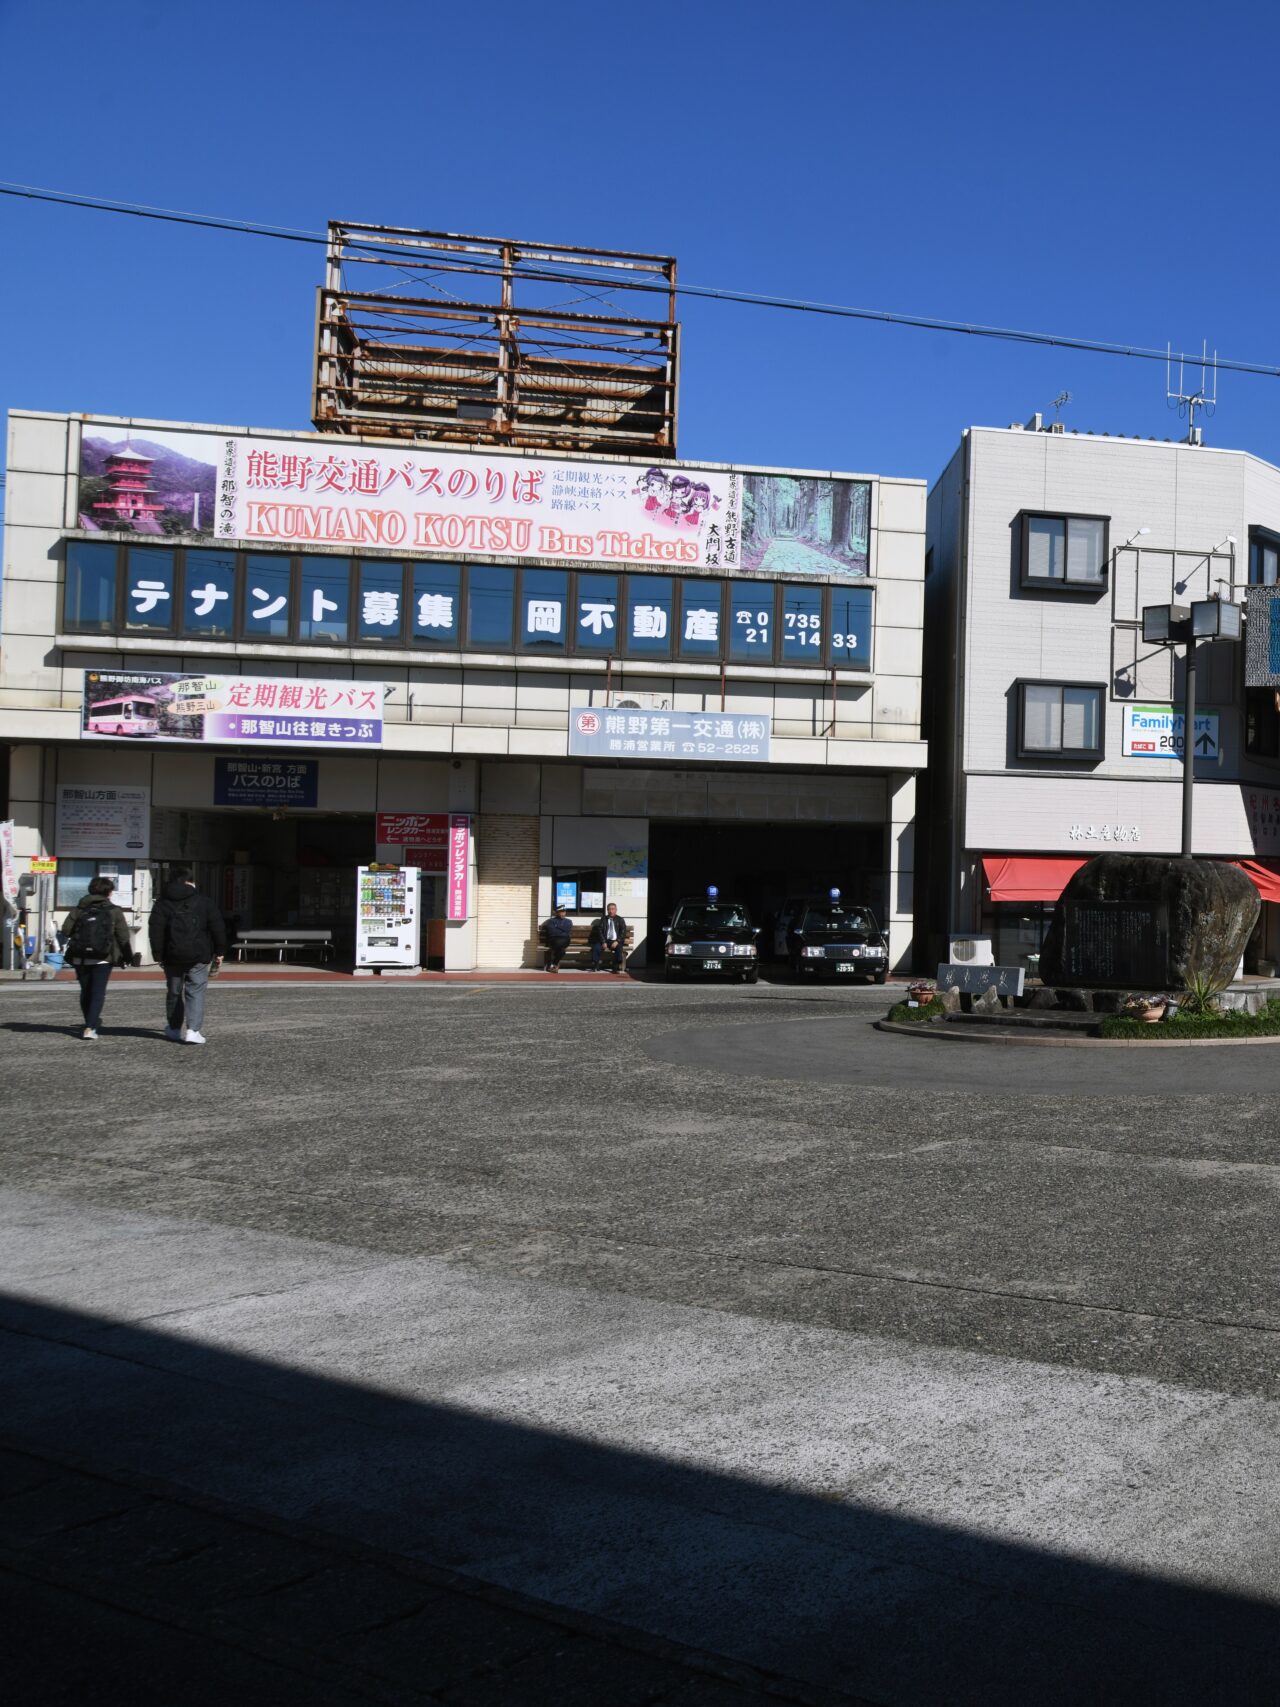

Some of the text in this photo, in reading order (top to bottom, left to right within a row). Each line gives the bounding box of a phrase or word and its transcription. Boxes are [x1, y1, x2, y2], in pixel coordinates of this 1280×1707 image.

[246, 449, 545, 504] 熊野交通バスのりば
[552, 470, 628, 485] 定期観光バス
[219, 480, 236, 536] 那智の滝
[551, 499, 602, 512] 路線バス
[246, 502, 699, 562] KUMANO KOTSU Bus Tickets
[725, 511, 738, 564] 熊野古道
[706, 524, 720, 565] 大門坂
[131, 581, 718, 641] テナント募集 岡不動産
[178, 680, 218, 692] 那智山
[227, 683, 377, 710] 定期観光バス
[175, 702, 216, 713] 熊野三山
[241, 719, 373, 737] 那智山往復きっぷ
[610, 739, 759, 754] 勝浦営業所 52-2525
[286, 764, 308, 774] 方面
[232, 774, 302, 788] バスのりば
[381, 816, 431, 827] ニッポン
